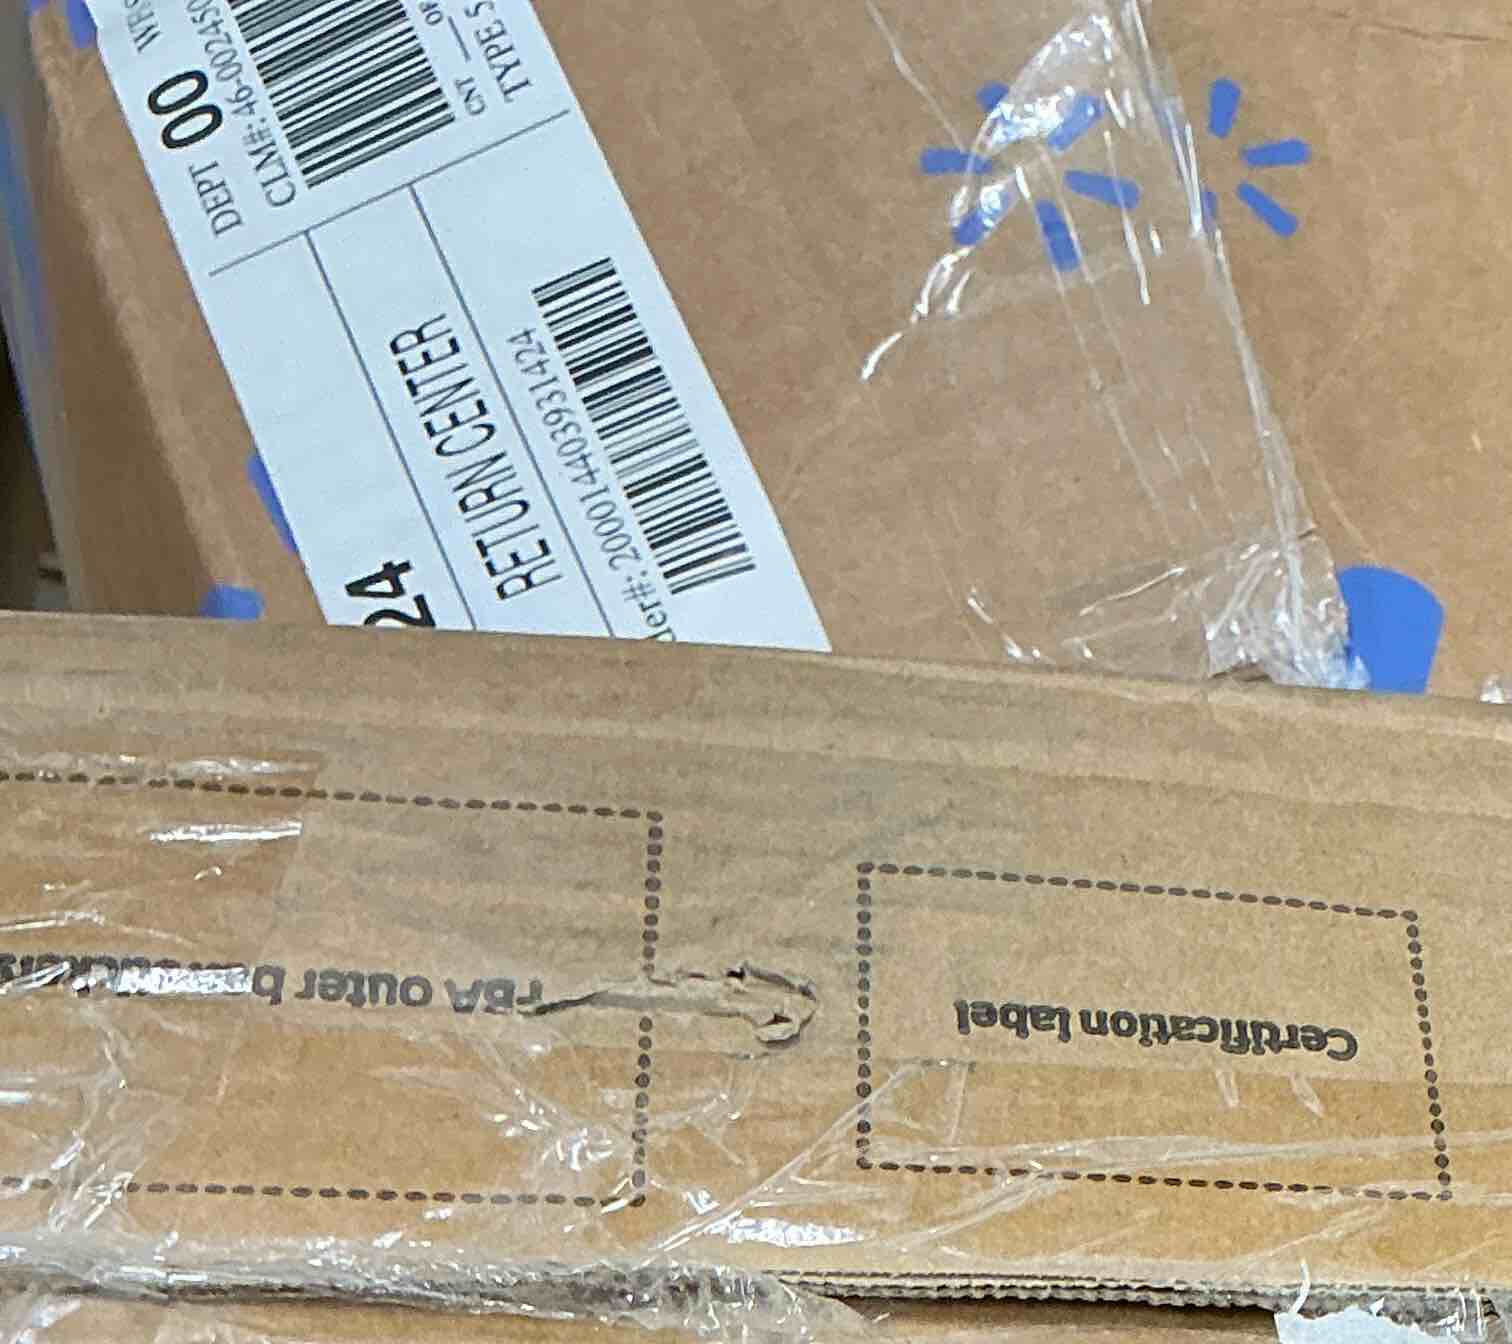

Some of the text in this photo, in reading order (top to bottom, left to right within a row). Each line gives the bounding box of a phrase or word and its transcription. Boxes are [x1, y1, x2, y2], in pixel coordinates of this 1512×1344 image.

[455, 76, 487, 115] CNT
[474, 19, 532, 102] TYPE
[147, 69, 224, 150] 00
[187, 165, 243, 236] DEPT
[248, 117, 297, 209] CLM#:
[390, 312, 563, 602] RETURN CENTER
[508, 328, 642, 571] 200014403931424
[296, 967, 433, 1008] outer
[953, 997, 1360, 1060] Certification label
